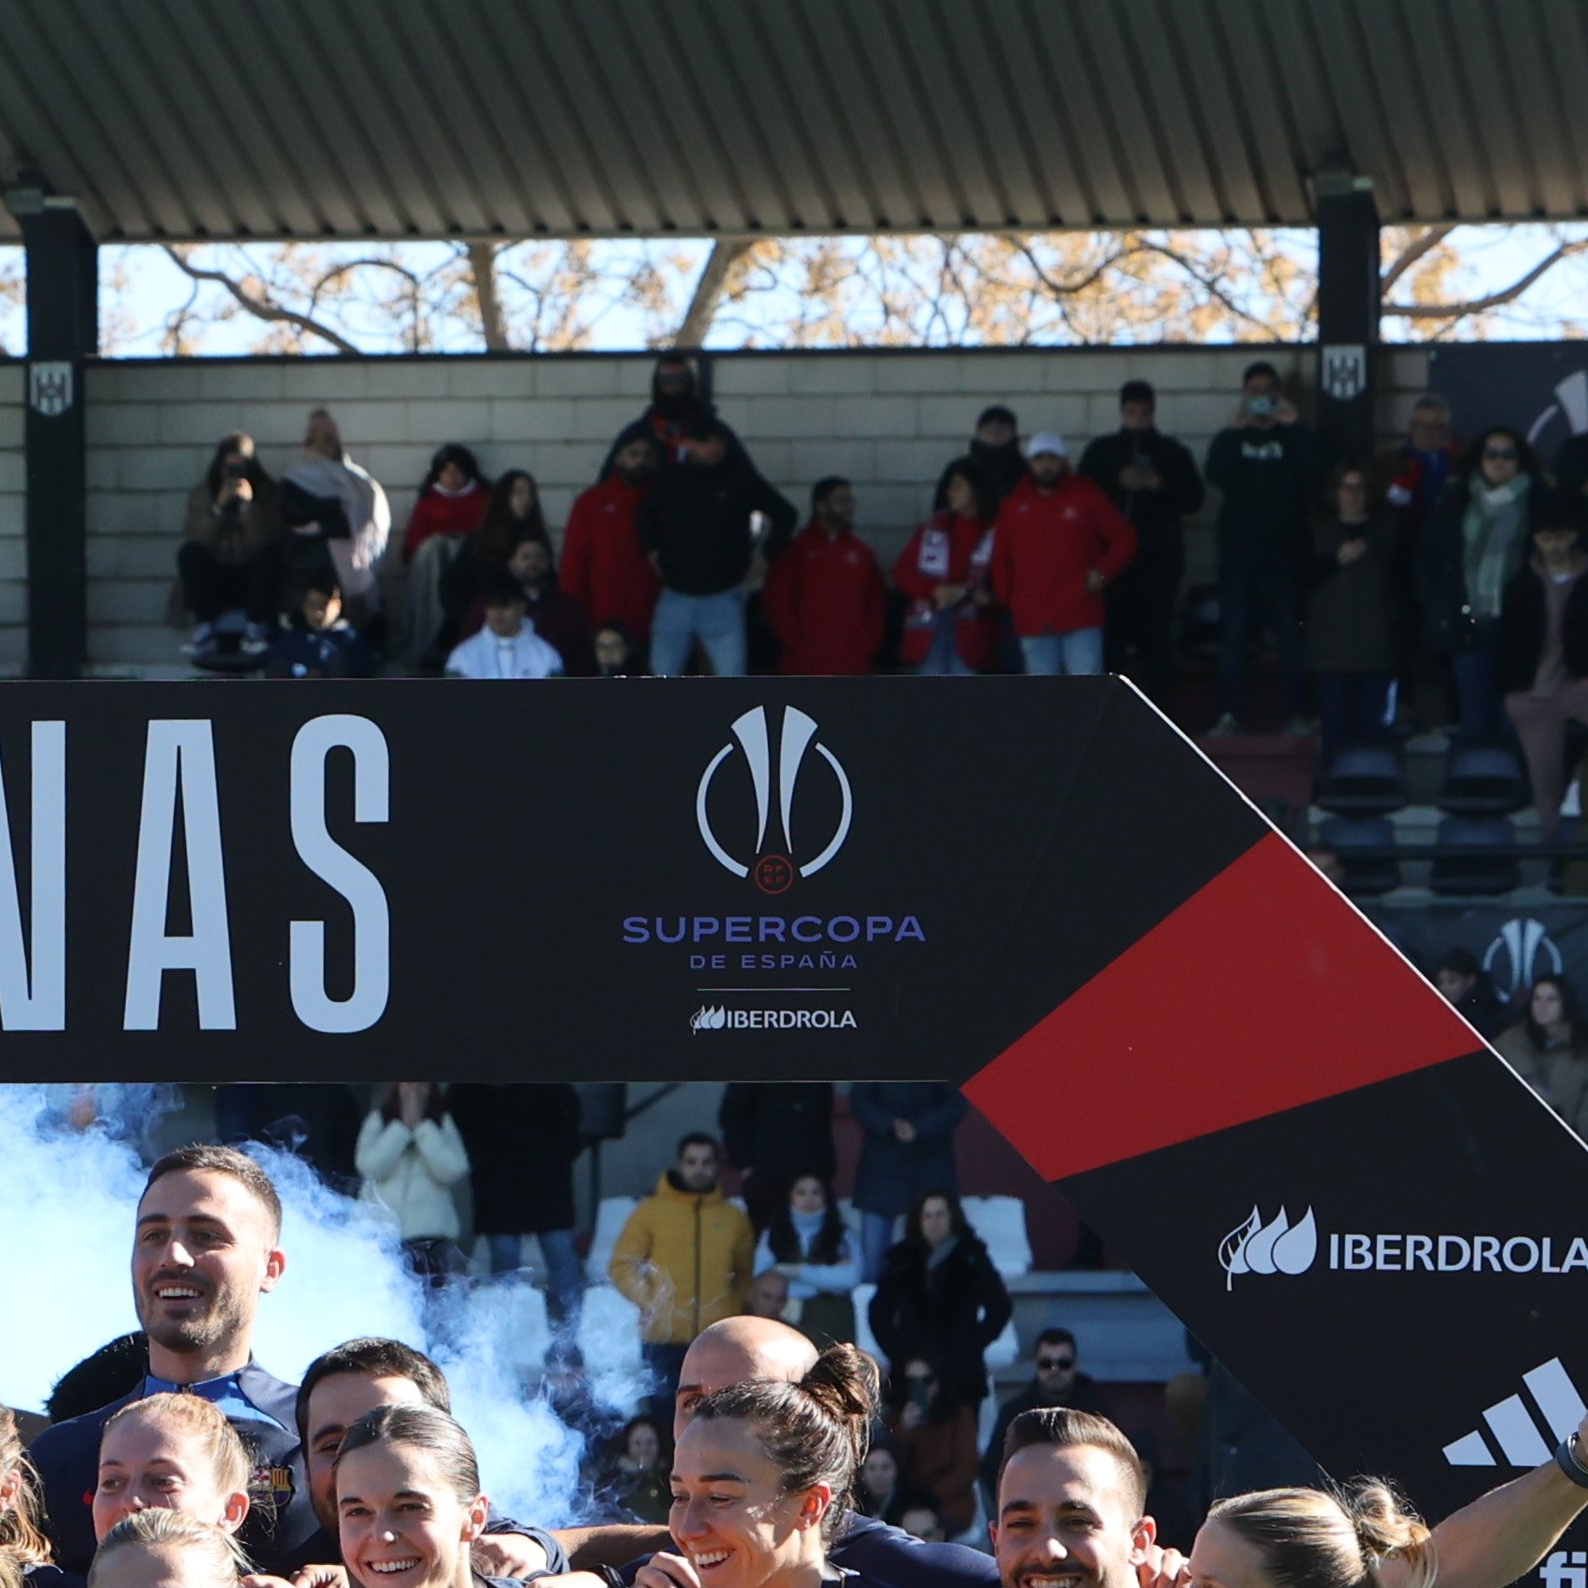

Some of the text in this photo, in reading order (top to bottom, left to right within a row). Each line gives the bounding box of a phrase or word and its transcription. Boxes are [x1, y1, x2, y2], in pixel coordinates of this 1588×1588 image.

[622, 914, 926, 944] SUPERCOPA
[689, 950, 858, 970] DE ESPAÑA
[727, 1010, 857, 1029] IBERDROLA
[1329, 1233, 1588, 1274] IBERDROLA
